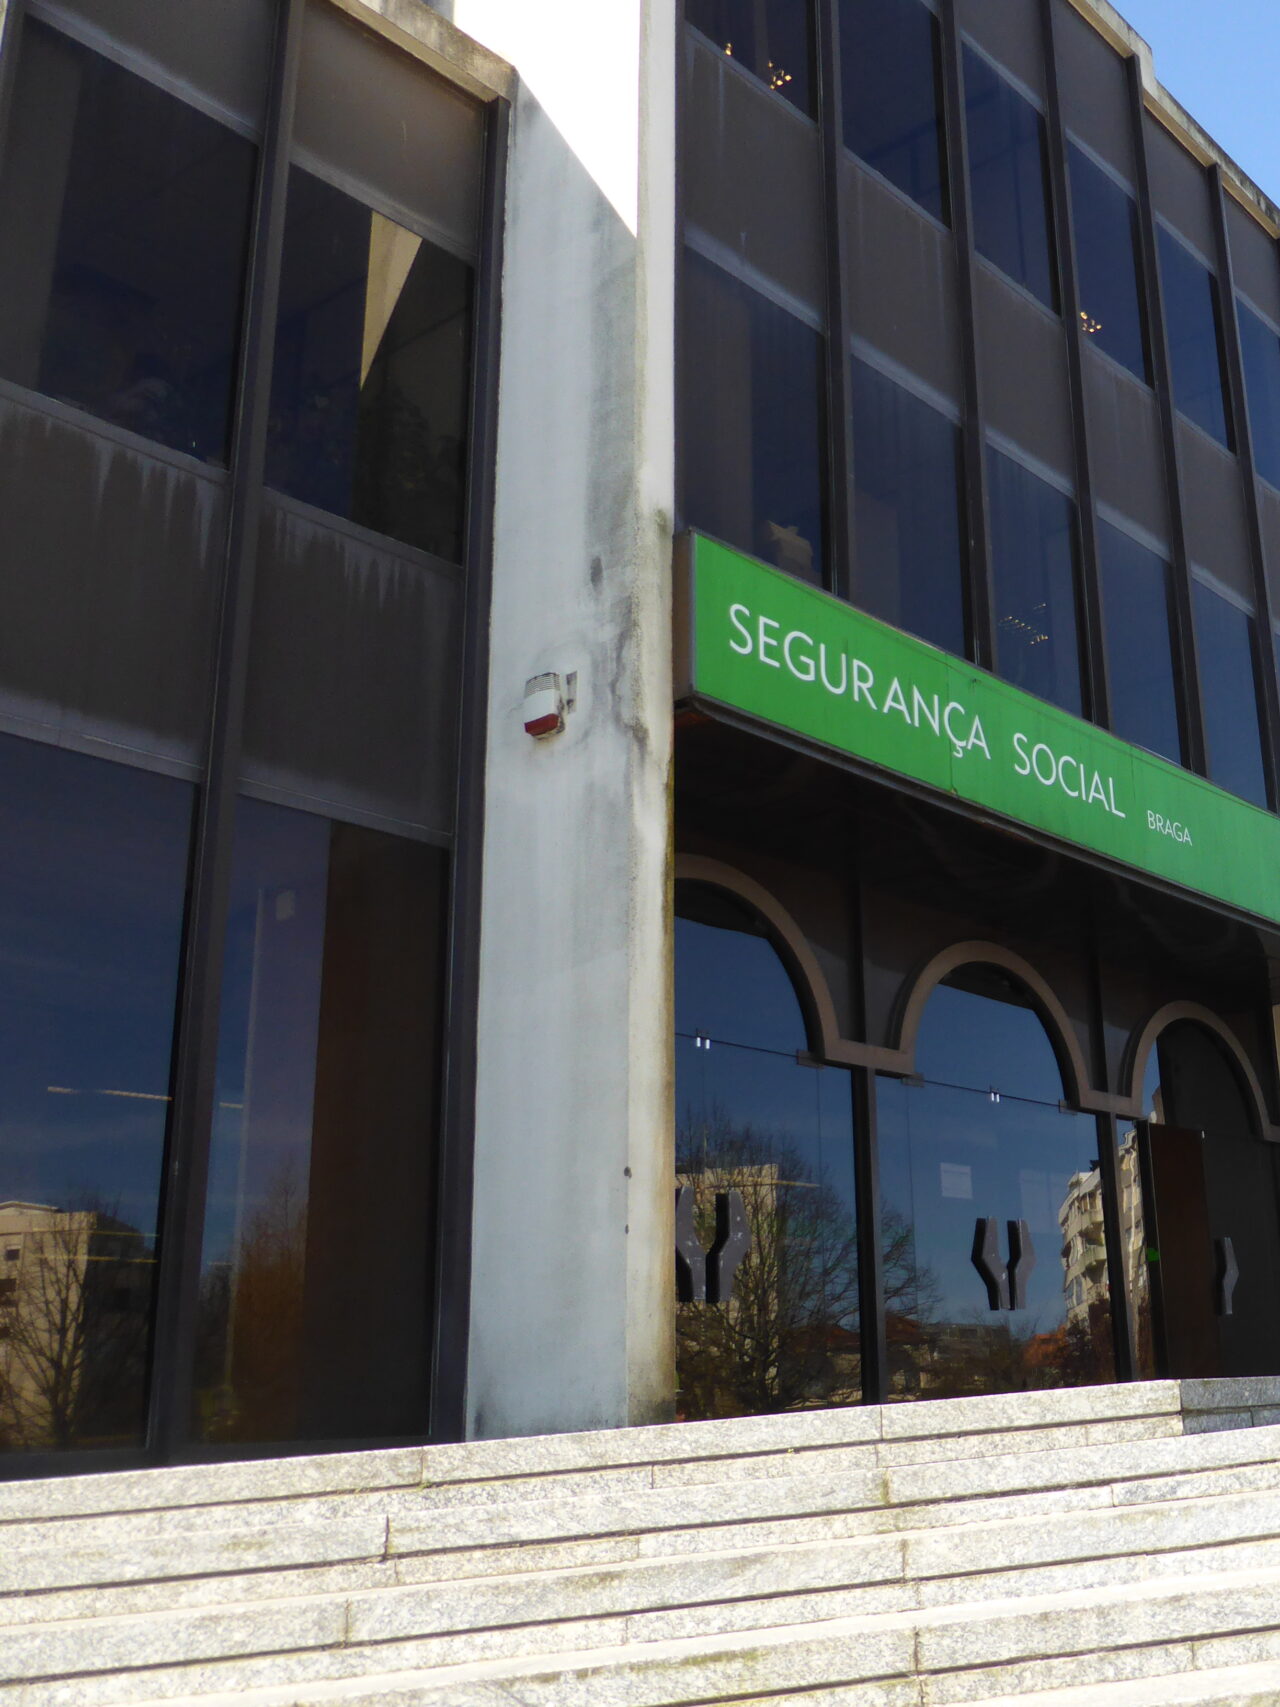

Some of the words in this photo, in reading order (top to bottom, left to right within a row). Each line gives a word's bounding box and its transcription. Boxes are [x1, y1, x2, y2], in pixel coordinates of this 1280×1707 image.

[728, 602, 992, 759] SEGURANÇA
[1012, 731, 1127, 819] SOCIAL
[1146, 809, 1193, 847] BRAGA
